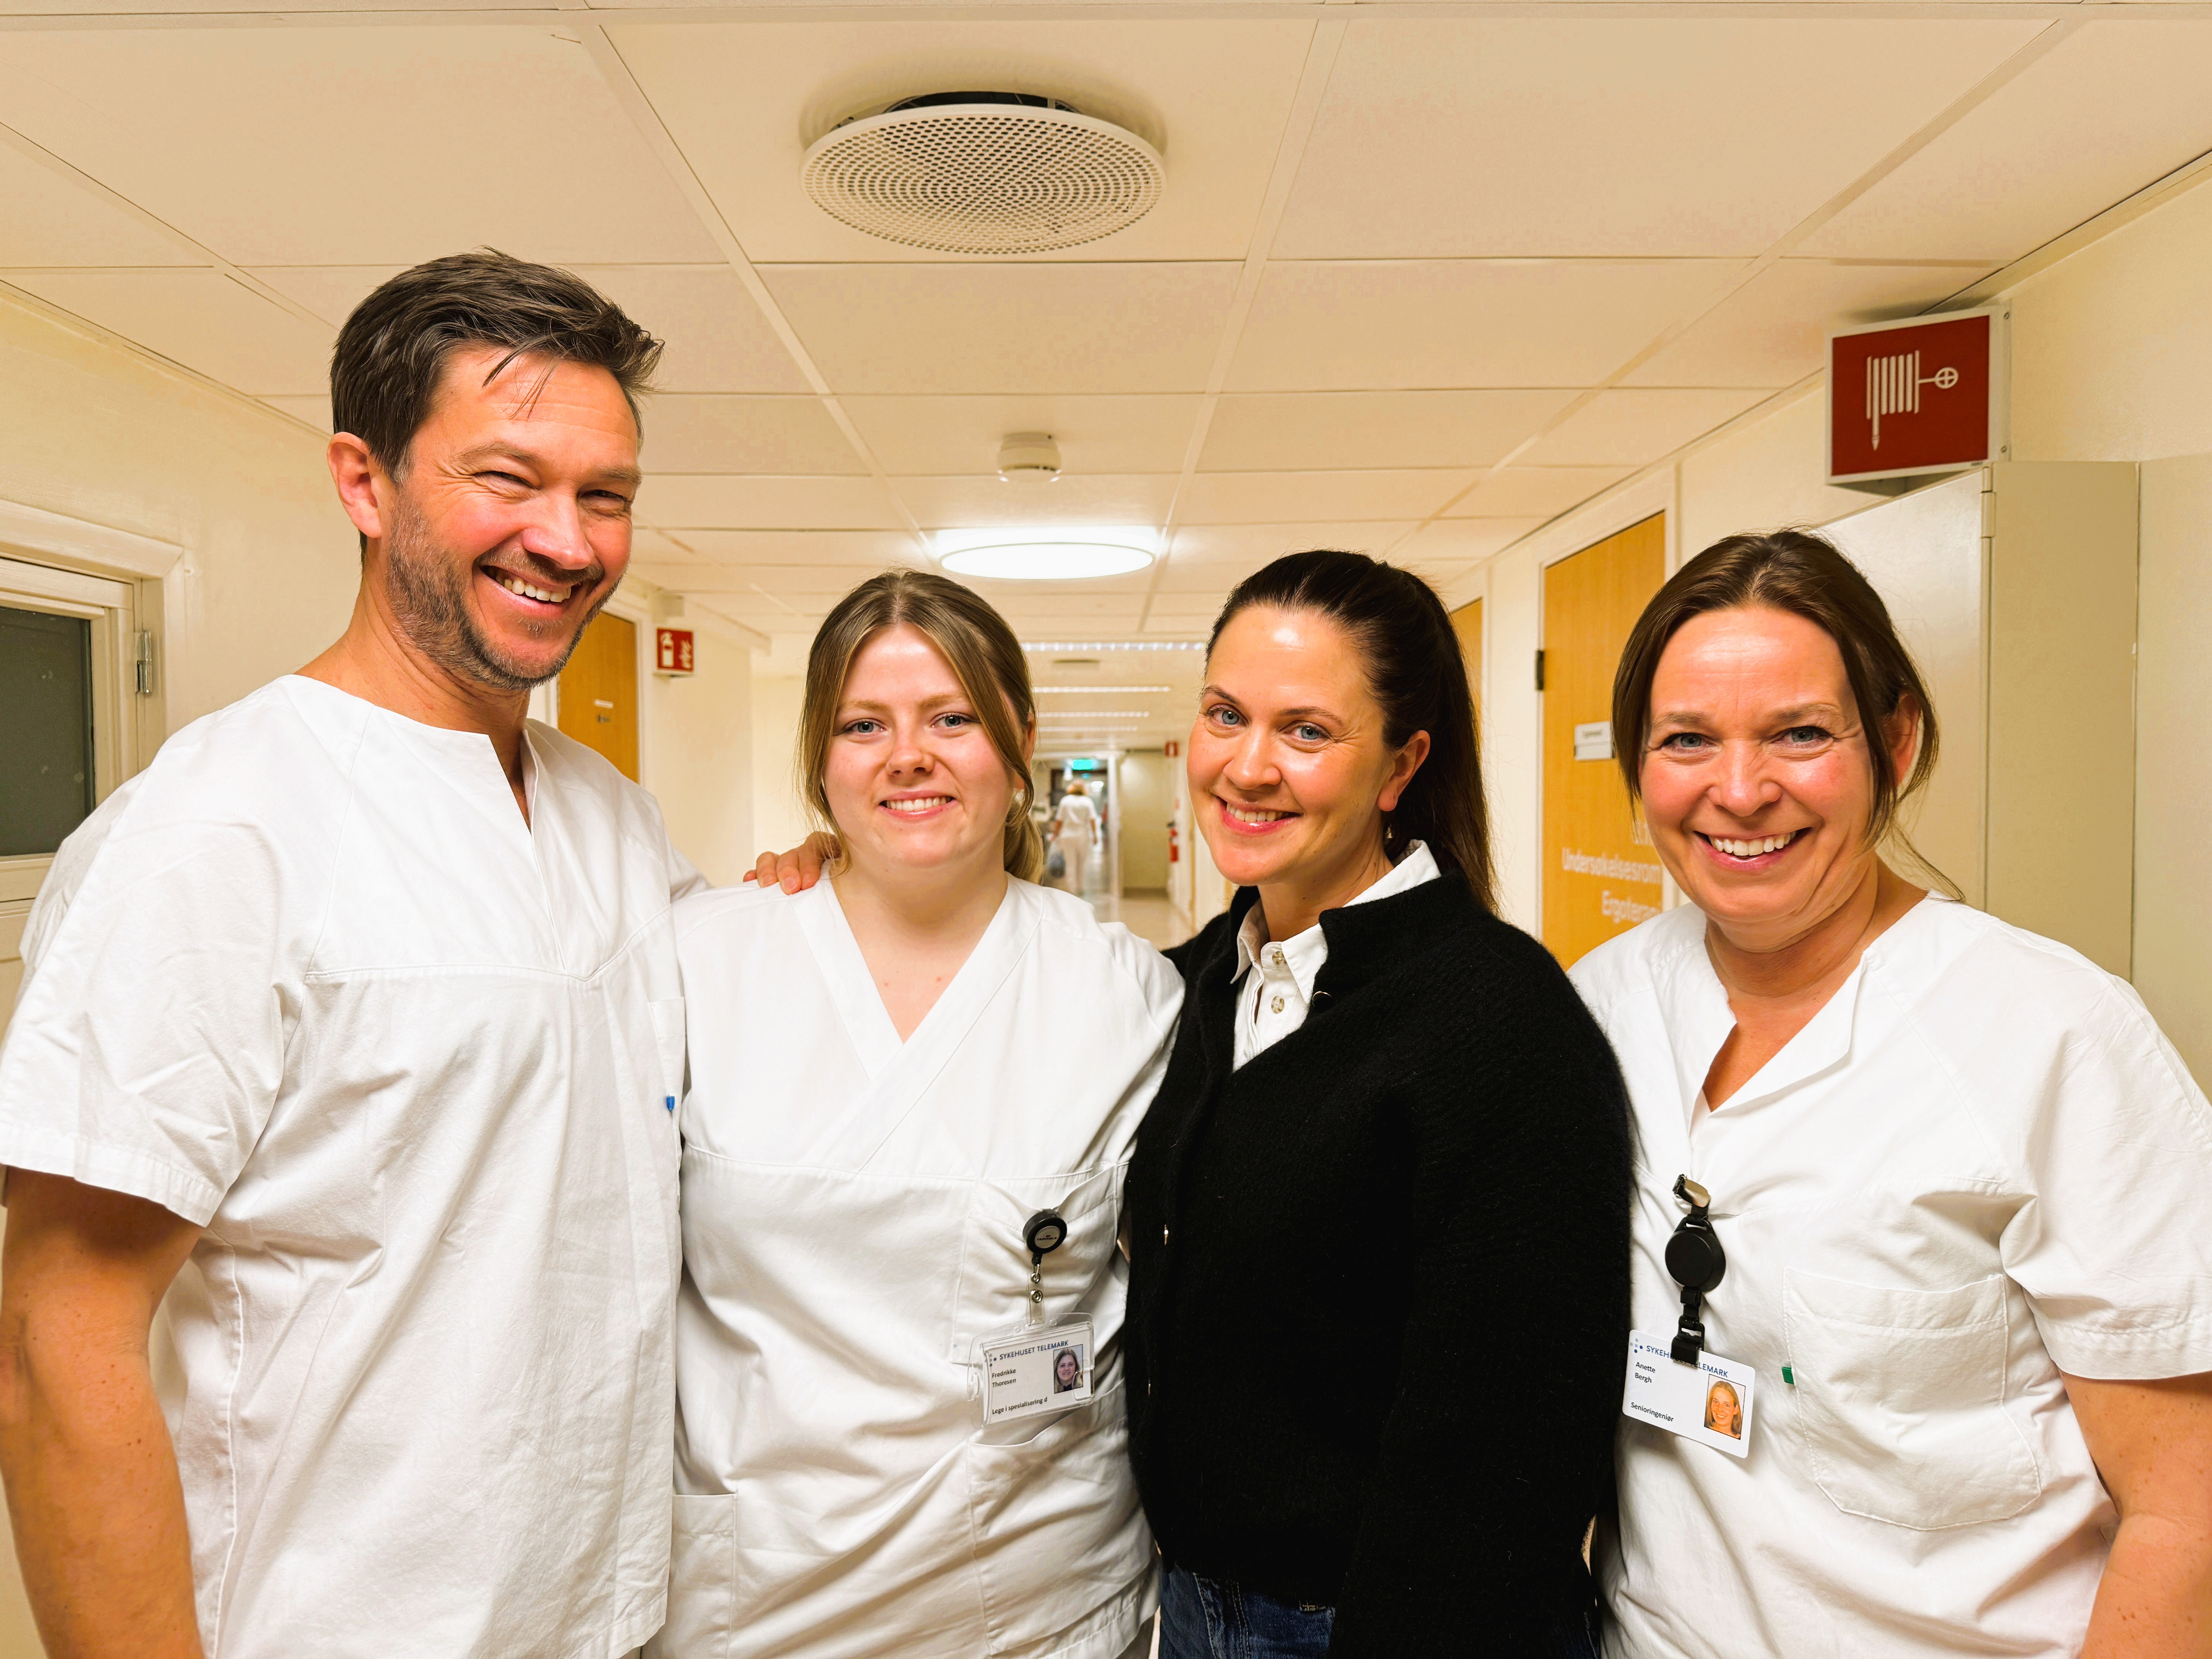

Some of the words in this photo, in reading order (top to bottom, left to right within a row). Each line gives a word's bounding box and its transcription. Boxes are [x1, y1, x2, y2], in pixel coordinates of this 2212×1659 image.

[1000, 1347, 1035, 1360] SYKEHUSET
[1037, 1340, 1069, 1352] TELEMARK
[1646, 1345, 1686, 1364] SYKEH
[1690, 1362, 1728, 1378] LEMARK
[1635, 1362, 1656, 1373] Anette
[992, 1369, 1017, 1378] Fredrikke
[1635, 1373, 1652, 1383] Bergh
[992, 1379, 1017, 1388] Thoresen
[1008, 1399, 1043, 1411] spesialisering
[1631, 1402, 1674, 1422] Senioringeniør
